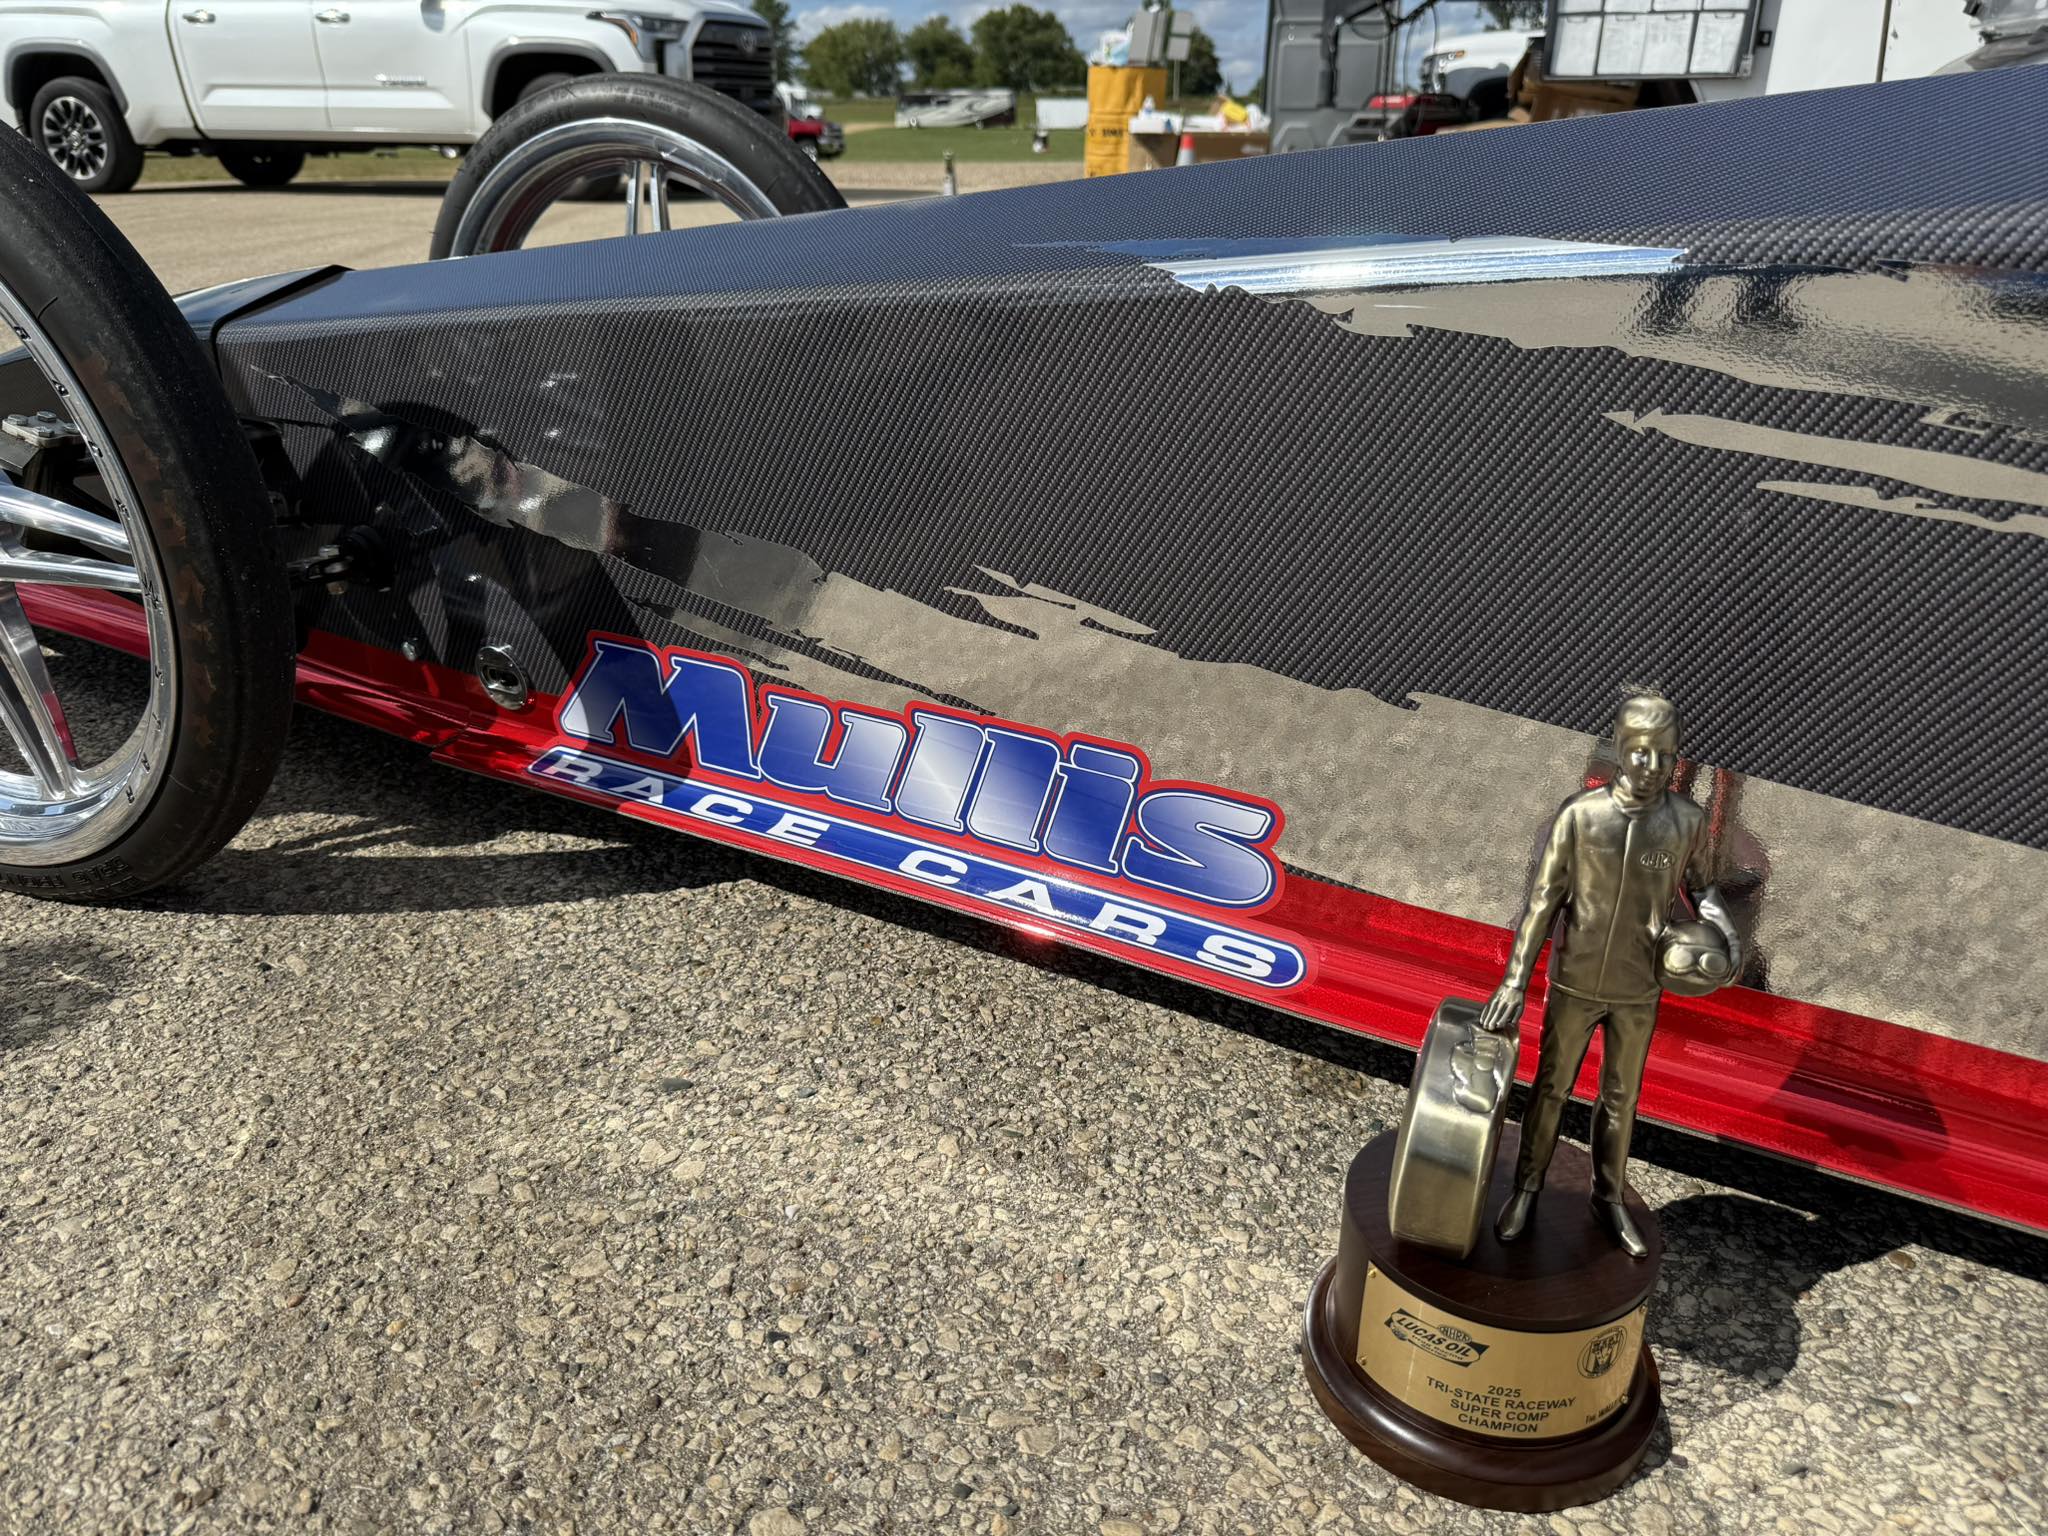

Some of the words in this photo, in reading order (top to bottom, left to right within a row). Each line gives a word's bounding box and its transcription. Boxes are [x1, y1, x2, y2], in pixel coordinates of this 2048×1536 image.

[560, 640, 1272, 903] Mullis
[543, 754, 831, 846] RACE
[898, 849, 1278, 978] CARS
[1396, 1317, 1447, 1345] LUCAS
[1444, 1342, 1472, 1358] OIL
[1426, 1375, 1500, 1407] TRI-STATE
[1504, 1396, 1577, 1411] RACEWAY
[1487, 1385, 1522, 1398] 2025
[1450, 1399, 1501, 1419] SUPER
[1505, 1410, 1550, 1422] COMP
[1457, 1412, 1538, 1433] CHAMPION
